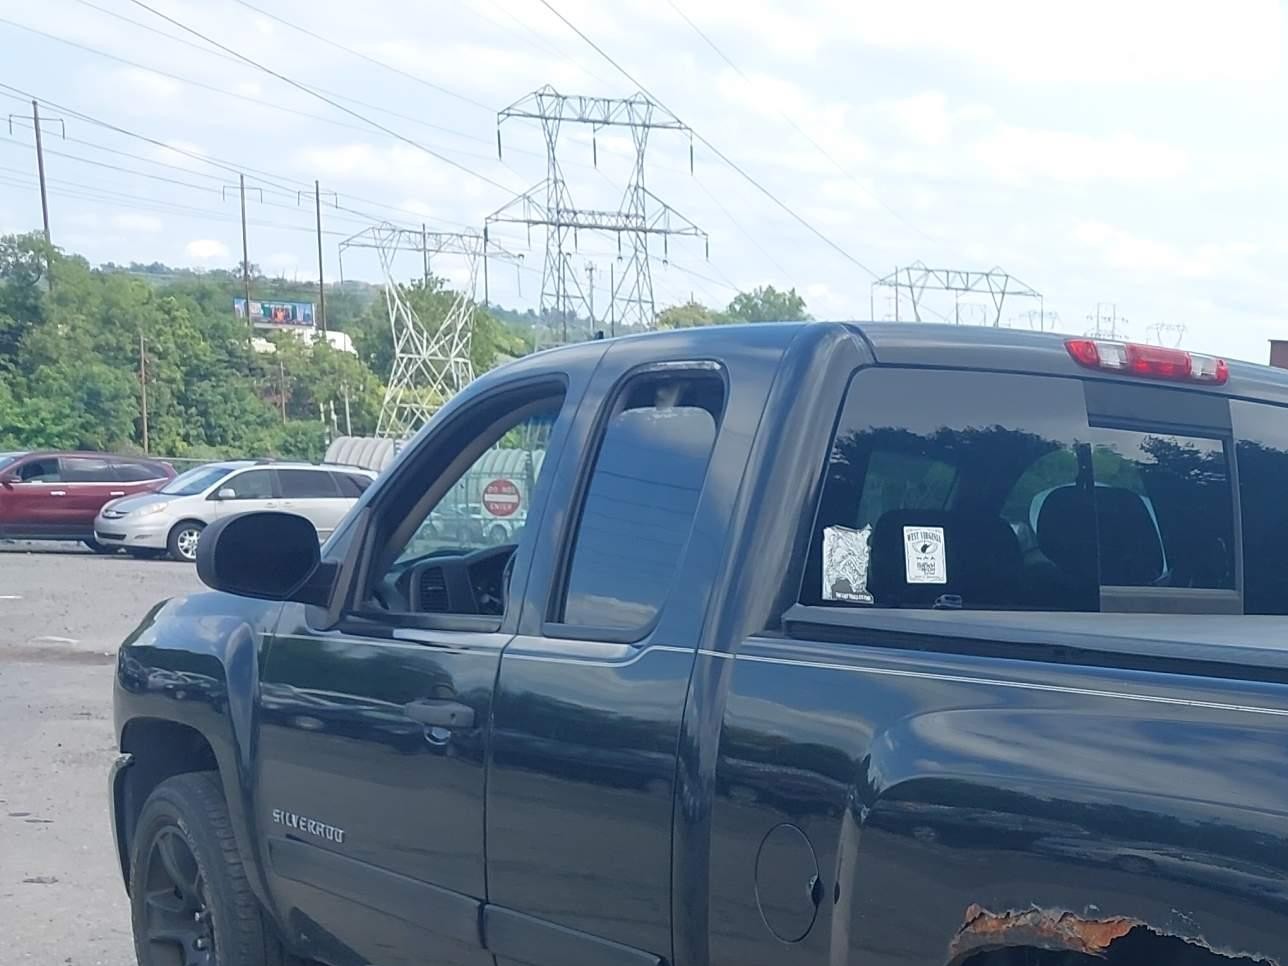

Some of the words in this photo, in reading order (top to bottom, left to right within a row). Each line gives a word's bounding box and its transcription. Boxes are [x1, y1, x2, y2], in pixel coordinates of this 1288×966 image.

[907, 531, 919, 542] WEST
[919, 531, 942, 544] VIRGINIA
[272, 808, 345, 843] SILVERADO
